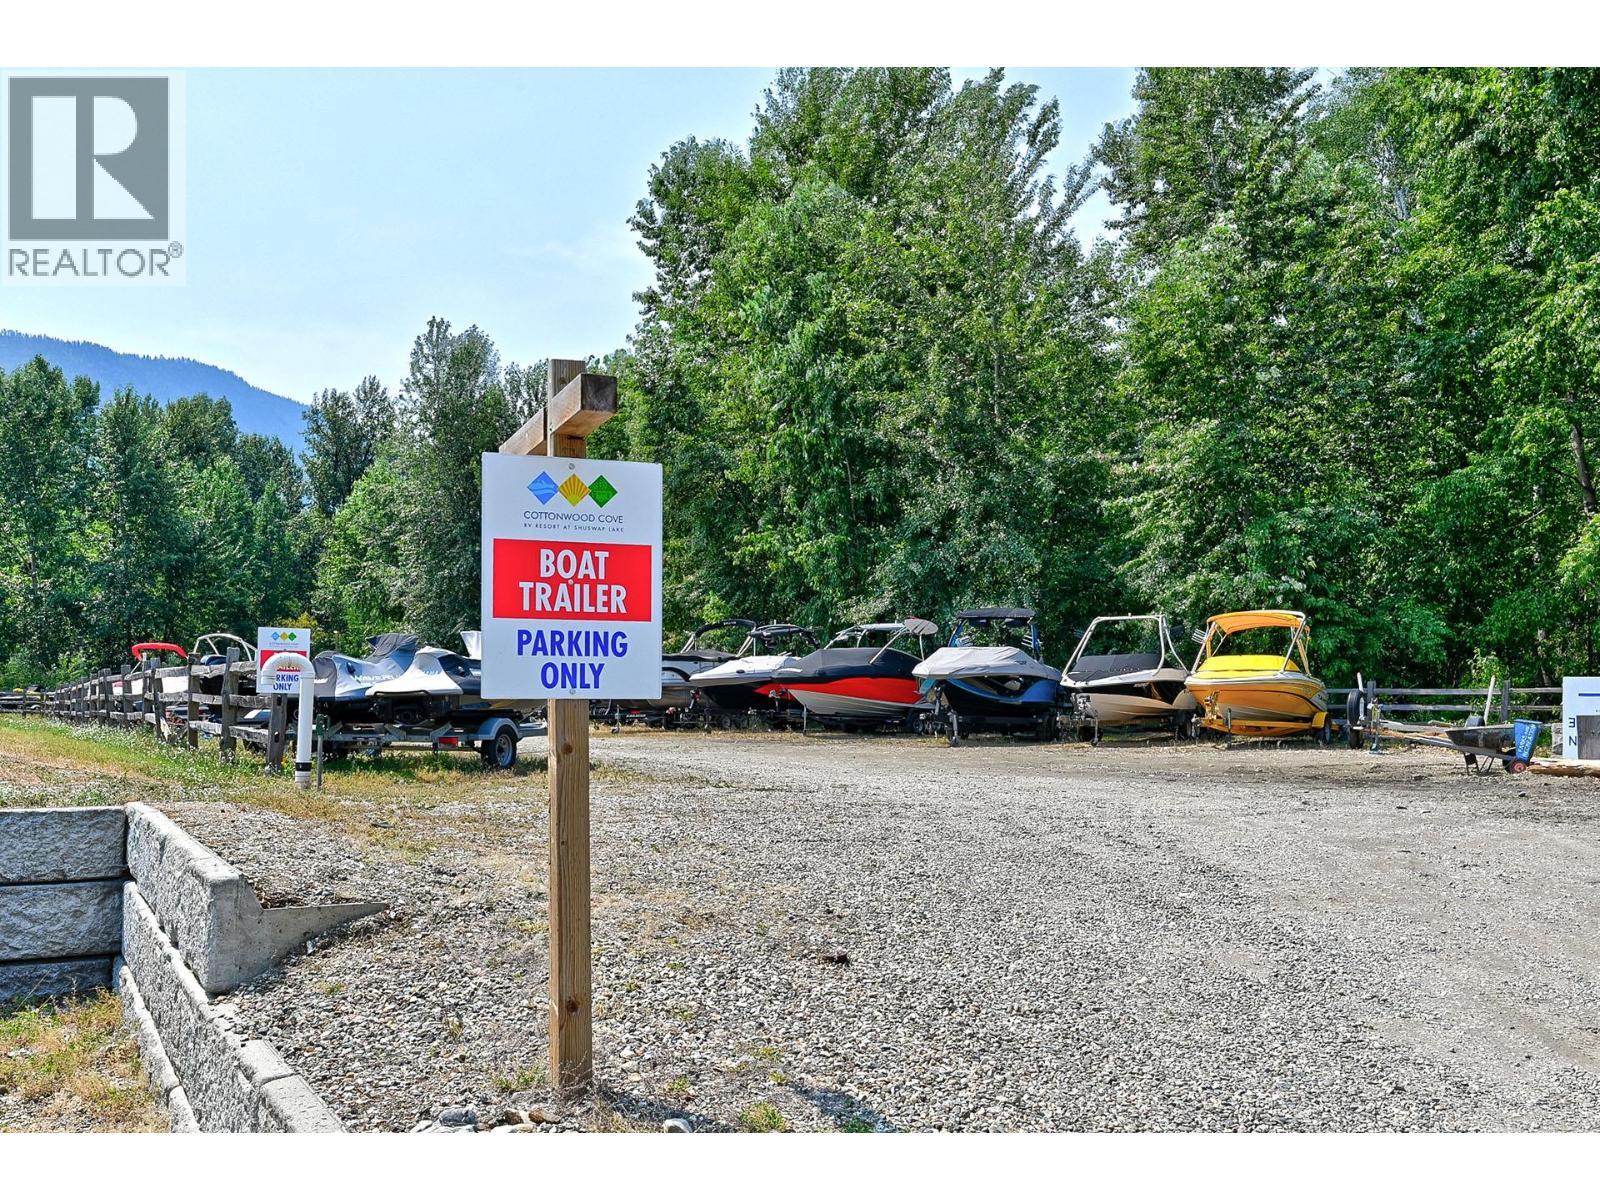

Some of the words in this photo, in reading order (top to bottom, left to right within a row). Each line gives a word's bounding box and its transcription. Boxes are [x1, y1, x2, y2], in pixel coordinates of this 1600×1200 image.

[523, 510, 596, 522] COTTONWOOD
[598, 514, 624, 524] COVE
[539, 548, 610, 580] BOAT
[518, 581, 628, 614] TRAILER
[517, 629, 629, 658] PARKING
[275, 674, 299, 682] RKING
[540, 661, 605, 690] ONLY
